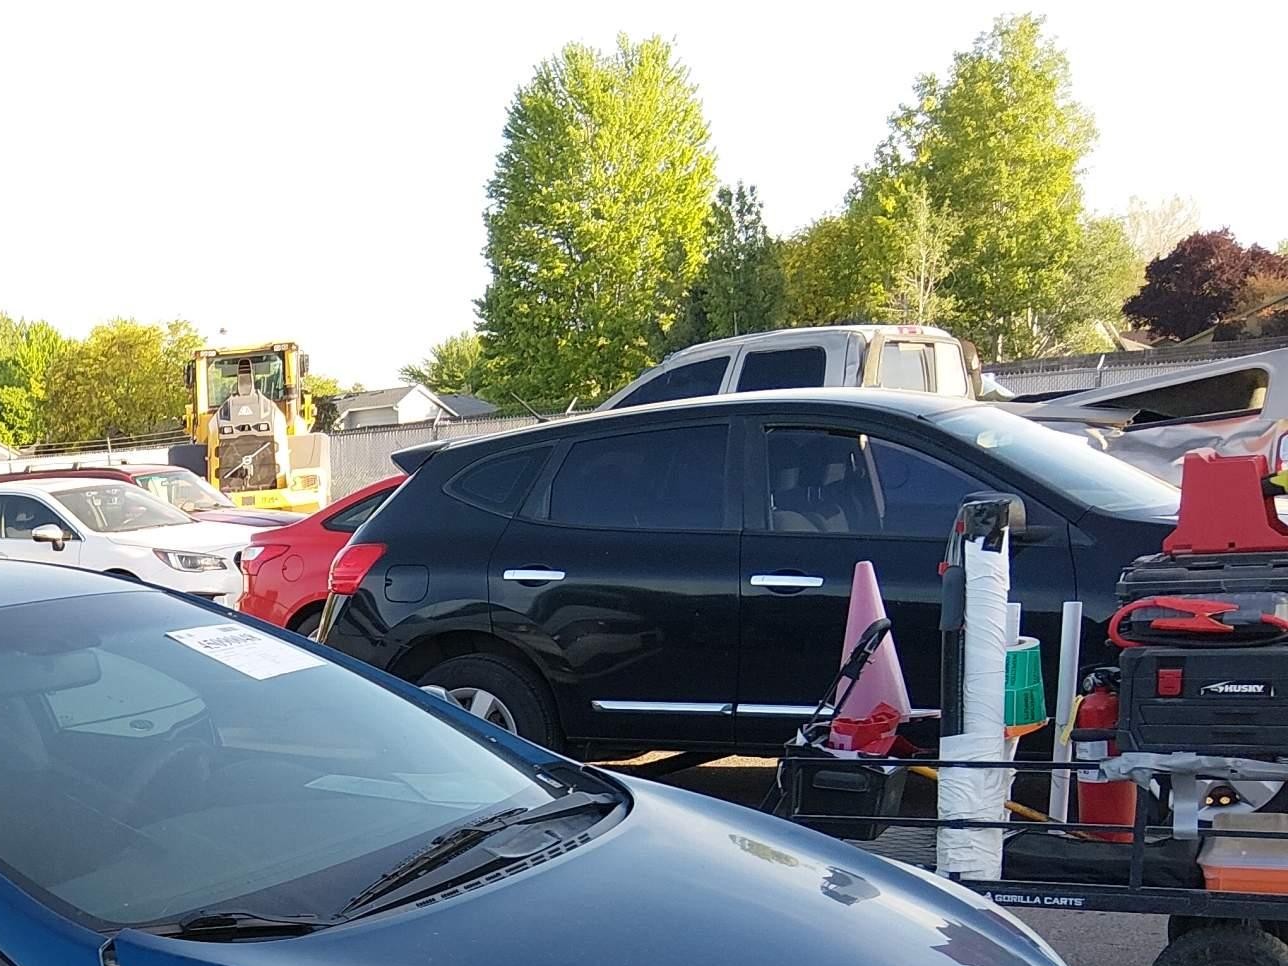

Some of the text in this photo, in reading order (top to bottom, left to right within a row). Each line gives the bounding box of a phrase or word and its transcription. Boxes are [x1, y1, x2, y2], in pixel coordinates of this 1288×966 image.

[1224, 684, 1264, 693] HUSKY
[994, 894, 1083, 906] GORILLA CARTS
